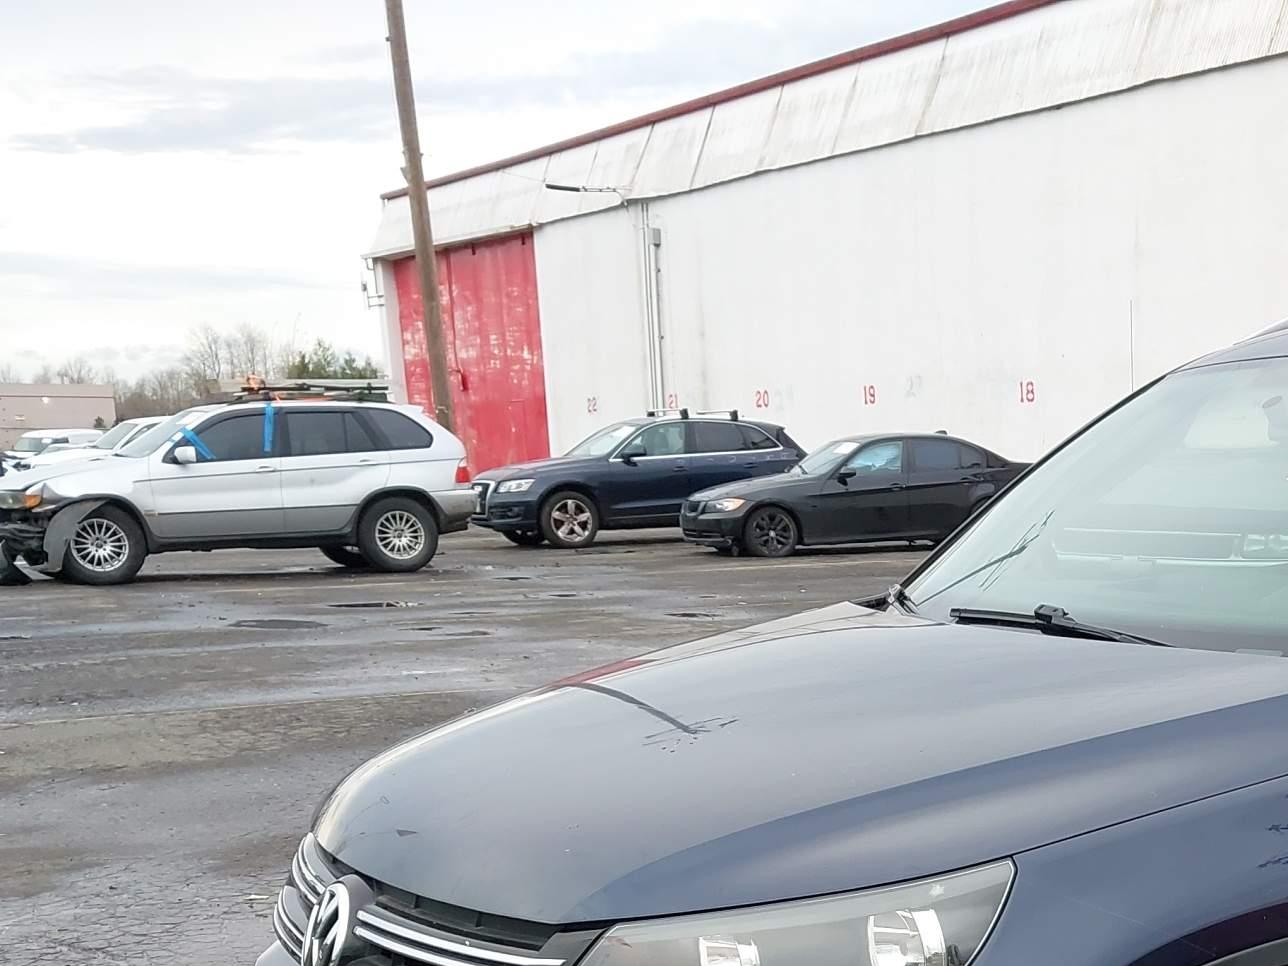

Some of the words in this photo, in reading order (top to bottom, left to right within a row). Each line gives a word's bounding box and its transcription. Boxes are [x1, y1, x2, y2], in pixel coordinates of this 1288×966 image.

[755, 389, 770, 409] 20
[863, 384, 876, 405] 19
[1018, 379, 1036, 404] 18
